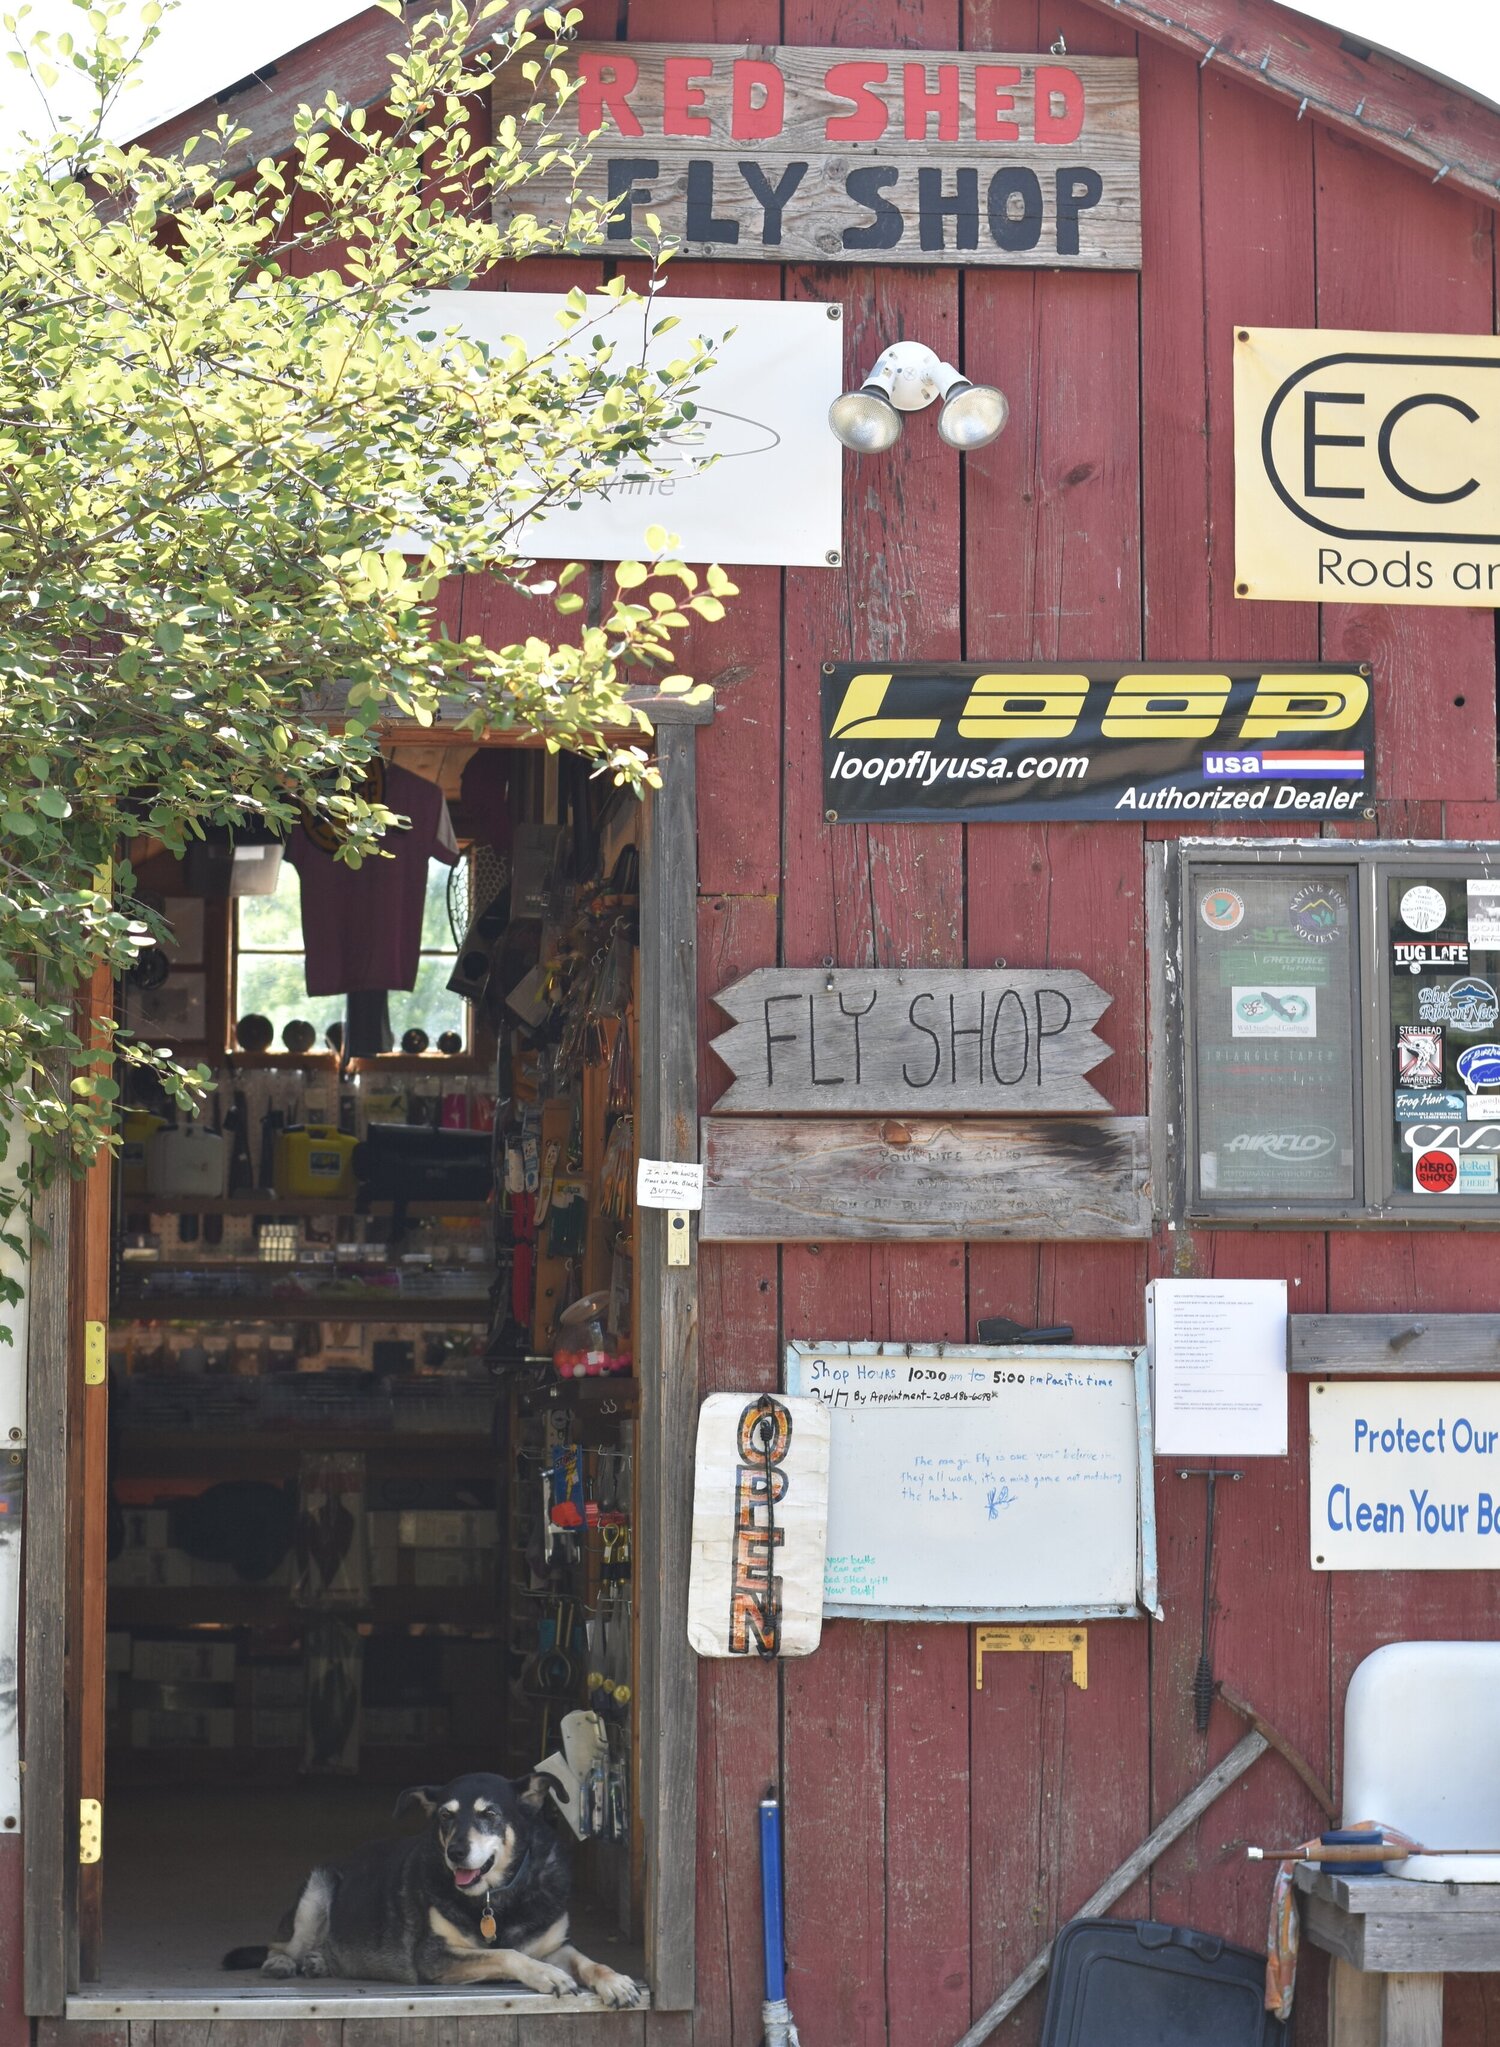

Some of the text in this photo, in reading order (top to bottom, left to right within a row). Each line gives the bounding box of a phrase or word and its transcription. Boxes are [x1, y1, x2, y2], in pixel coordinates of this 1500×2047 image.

[577, 53, 1085, 144] RED SHED
[607, 158, 1103, 255] FLY SHOP
[1318, 548, 1433, 588] Rods
[829, 674, 1369, 739] LOOP
[830, 751, 1090, 786] loopflyusa.com
[1206, 756, 1261, 774] usa
[1115, 786, 1364, 810] Authorized Dealer
[1290, 884, 1324, 912] NATIVE
[1293, 923, 1341, 944] SOCIETY
[1394, 945, 1427, 961] TUG
[1418, 985, 1452, 1004] Blue
[1419, 1002, 1500, 1023] Ribbon Nets
[764, 989, 1072, 1088] FLY SHOP
[1399, 1025, 1442, 1035] STEELHEAD
[1206, 1050, 1334, 1062] TRIANGLE TAPER
[1399, 1076, 1443, 1085] AWARENESS
[1396, 1092, 1446, 1110] Frog Hair
[1223, 1133, 1331, 1152] AIRFLO
[1419, 1162, 1455, 1172] HERO
[1419, 1172, 1455, 1182] SHOTS
[811, 1360, 850, 1385] Shop
[993, 1370, 1026, 1384] 5:00
[854, 1391, 867, 1405] By
[1355, 1418, 1498, 1454] Protect Our
[928, 1471, 945, 1482] all
[1327, 1483, 1405, 1534] Clean
[1409, 1489, 1470, 1535] Your
[729, 1397, 793, 1655] OPEN
